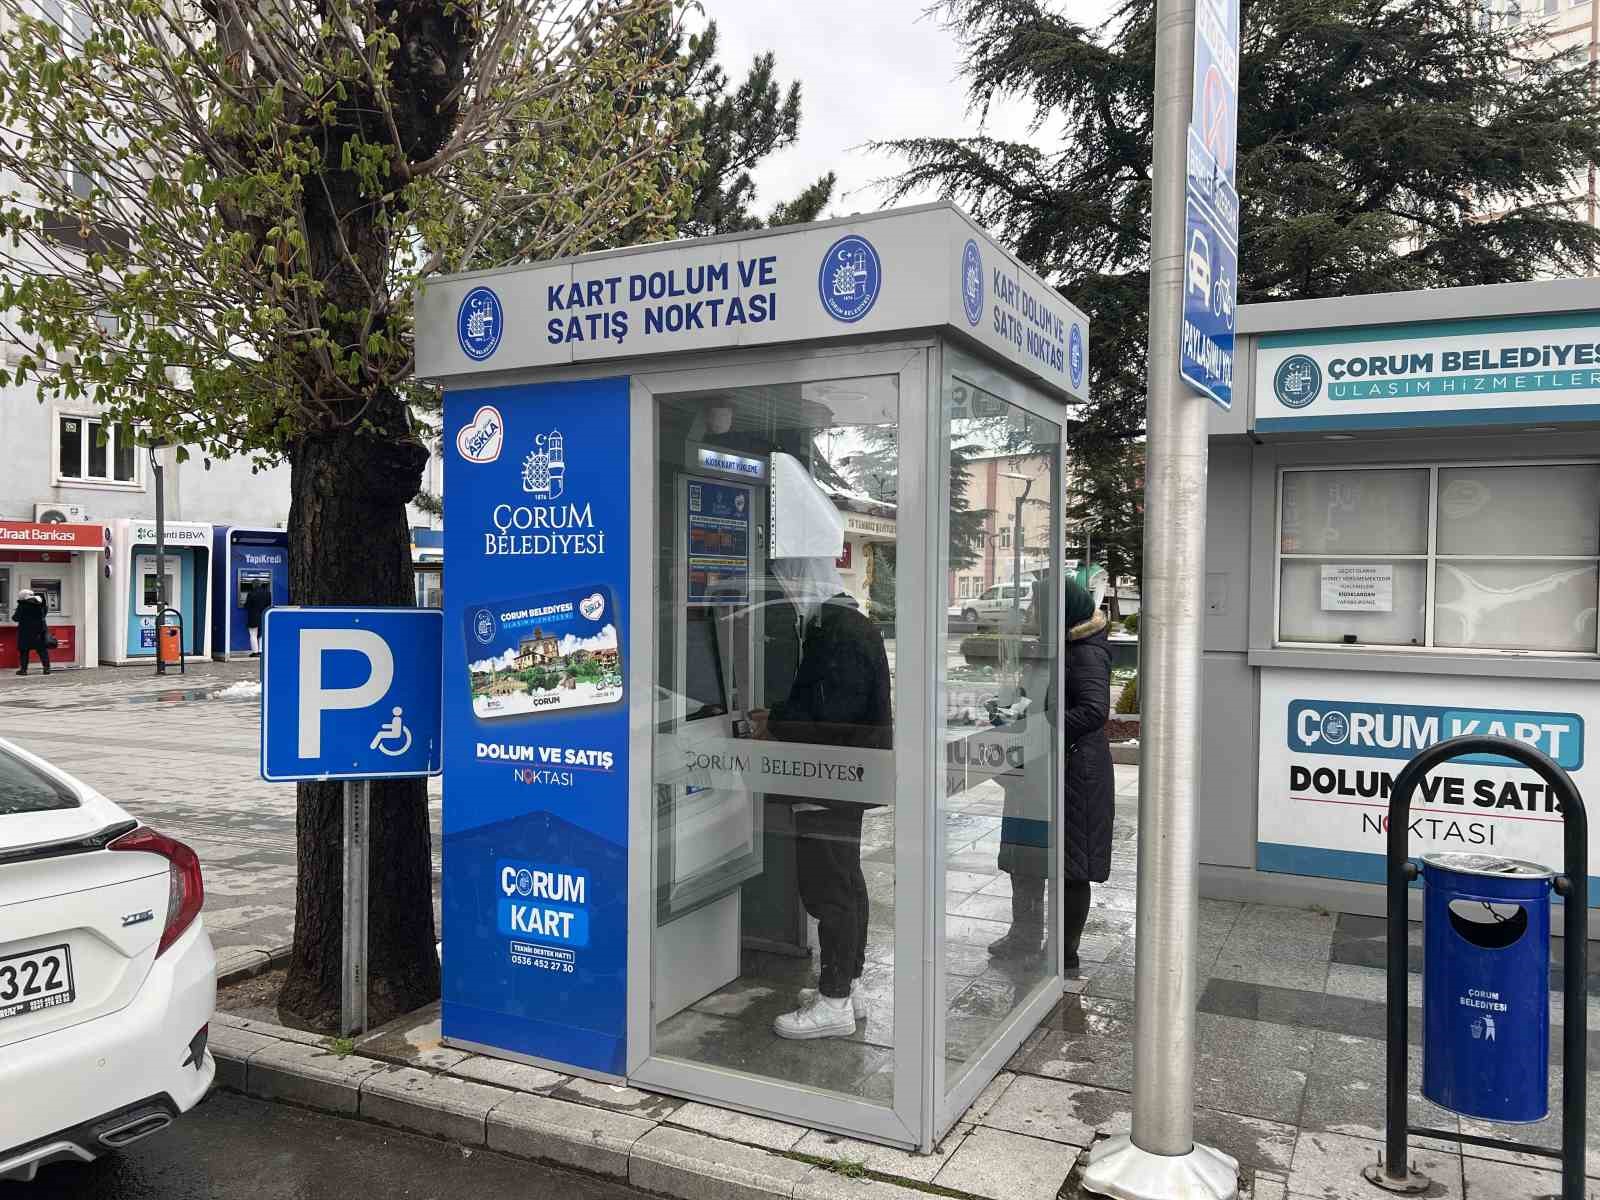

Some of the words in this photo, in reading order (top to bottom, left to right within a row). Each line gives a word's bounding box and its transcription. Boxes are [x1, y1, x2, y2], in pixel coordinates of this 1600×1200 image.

[547, 277, 622, 311] KART
[629, 262, 729, 302] DOLUM
[737, 256, 777, 287] VE
[547, 310, 628, 344] SATIŞ
[644, 292, 776, 335] NOKTASI
[993, 267, 1020, 311] KART
[1022, 291, 1051, 335] DOLUM
[1051, 315, 1064, 344] VE
[993, 305, 1023, 353] SATIŞ
[1027, 327, 1064, 373] NOKTASI
[1183, 319, 1222, 381] PAYLAŞIMLI
[1328, 353, 1433, 380] ÇORUM
[1334, 381, 1431, 398] ULAŞIM
[493, 503, 595, 535] ÇORUM
[31, 528, 75, 541] Bankası
[146, 529, 178, 539] Gnti
[179, 531, 205, 539] BBVA
[485, 530, 605, 555] BELEDİYESİ
[500, 609, 529, 622] ÇORUM
[529, 602, 573, 617] BELEDİYESİ
[297, 628, 394, 759] P
[533, 696, 561, 707] ÇORUM
[1296, 709, 1440, 749] ÇORUM
[476, 742, 534, 761] DOLUM
[538, 746, 562, 763] VE
[564, 749, 614, 769] SATIŞ
[514, 768, 574, 787] NOKTASI
[1419, 776, 1465, 806] VE
[501, 866, 585, 904] ÇORUM
[511, 904, 575, 939] KART
[511, 955, 532, 966] 0536
[533, 959, 549, 969] 452
[550, 962, 561, 971] 27
[562, 963, 574, 973] 30
[533, 947, 554, 957] DESTEK
[554, 951, 572, 960] HATTI
[0, 955, 63, 1000] 322
[1468, 988, 1499, 1001] ÇORUM
